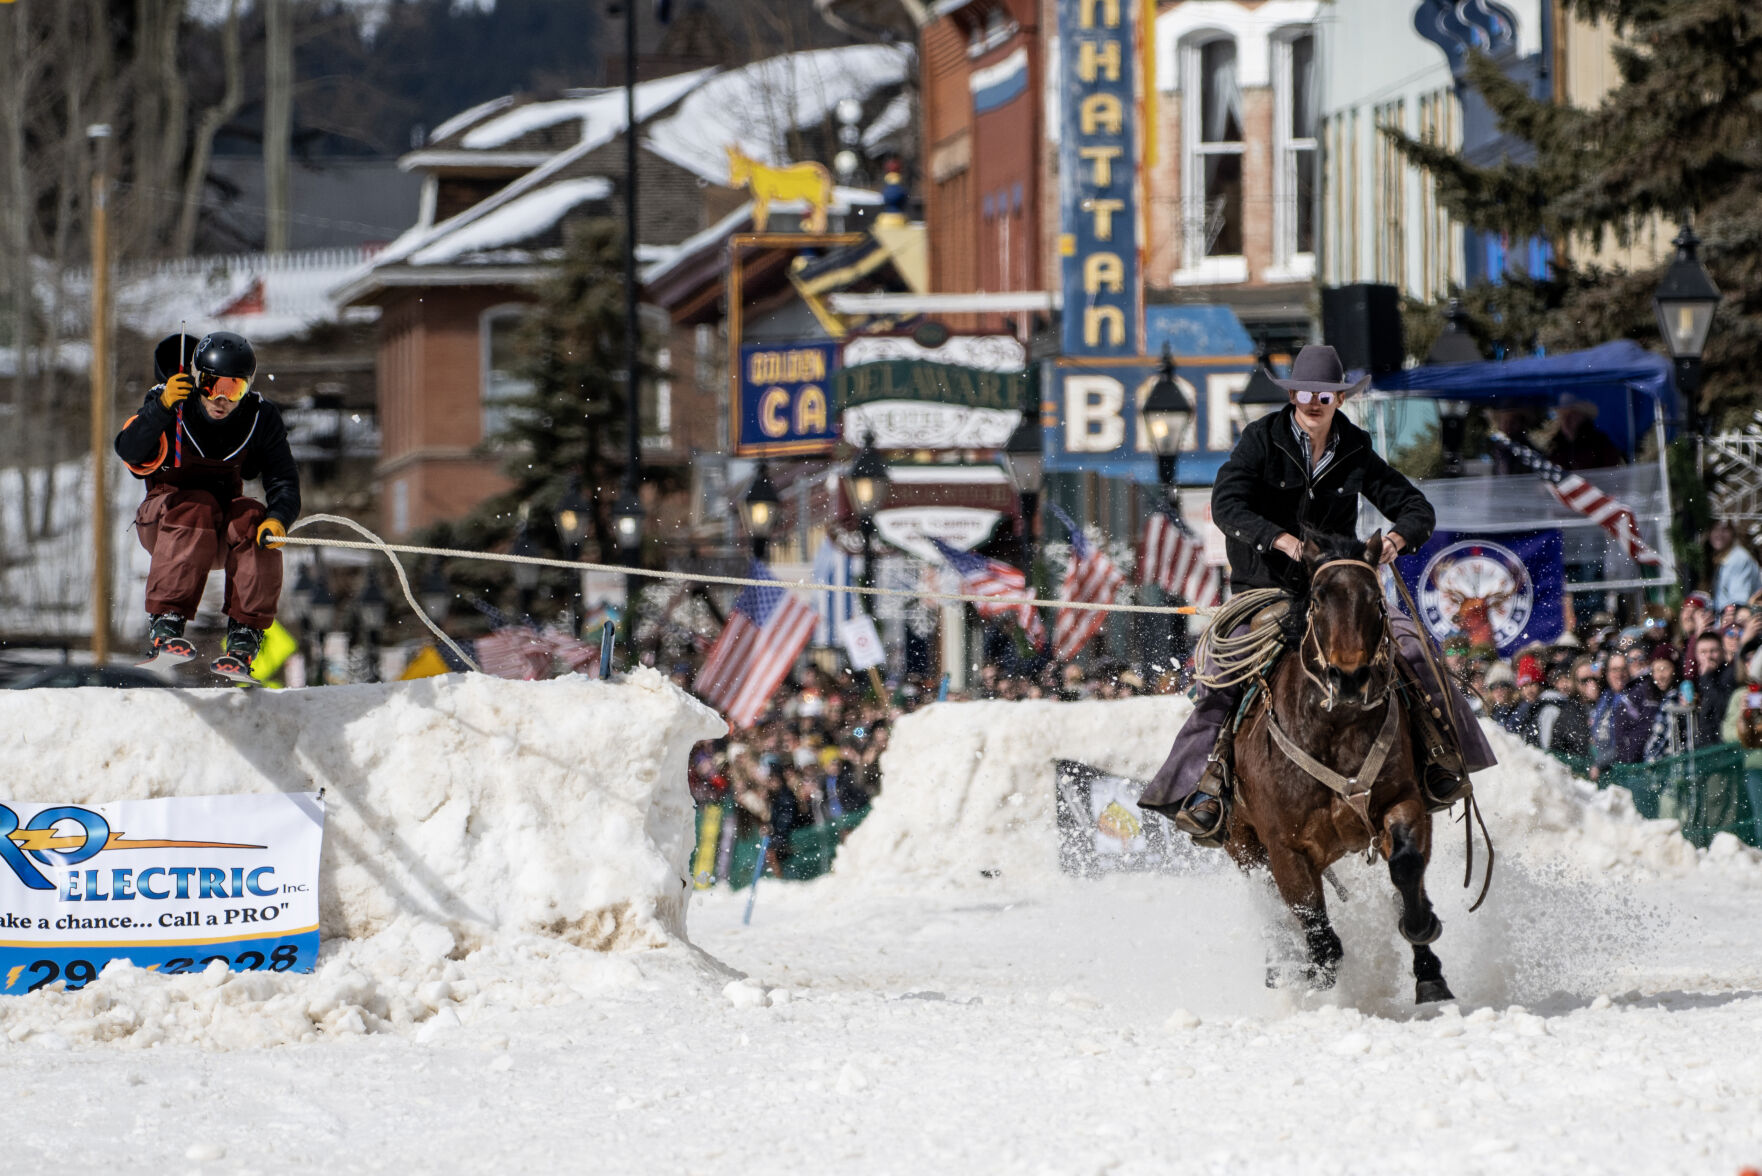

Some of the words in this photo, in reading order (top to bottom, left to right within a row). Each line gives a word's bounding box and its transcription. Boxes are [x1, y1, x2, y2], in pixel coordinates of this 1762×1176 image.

[59, 866, 279, 902] ELECTRIC
[283, 883, 310, 894] Inc.
[38, 918, 50, 929] a
[56, 914, 153, 930] chance...
[158, 912, 200, 927] Call
[206, 914, 218, 925] a
[28, 959, 110, 994] 29
